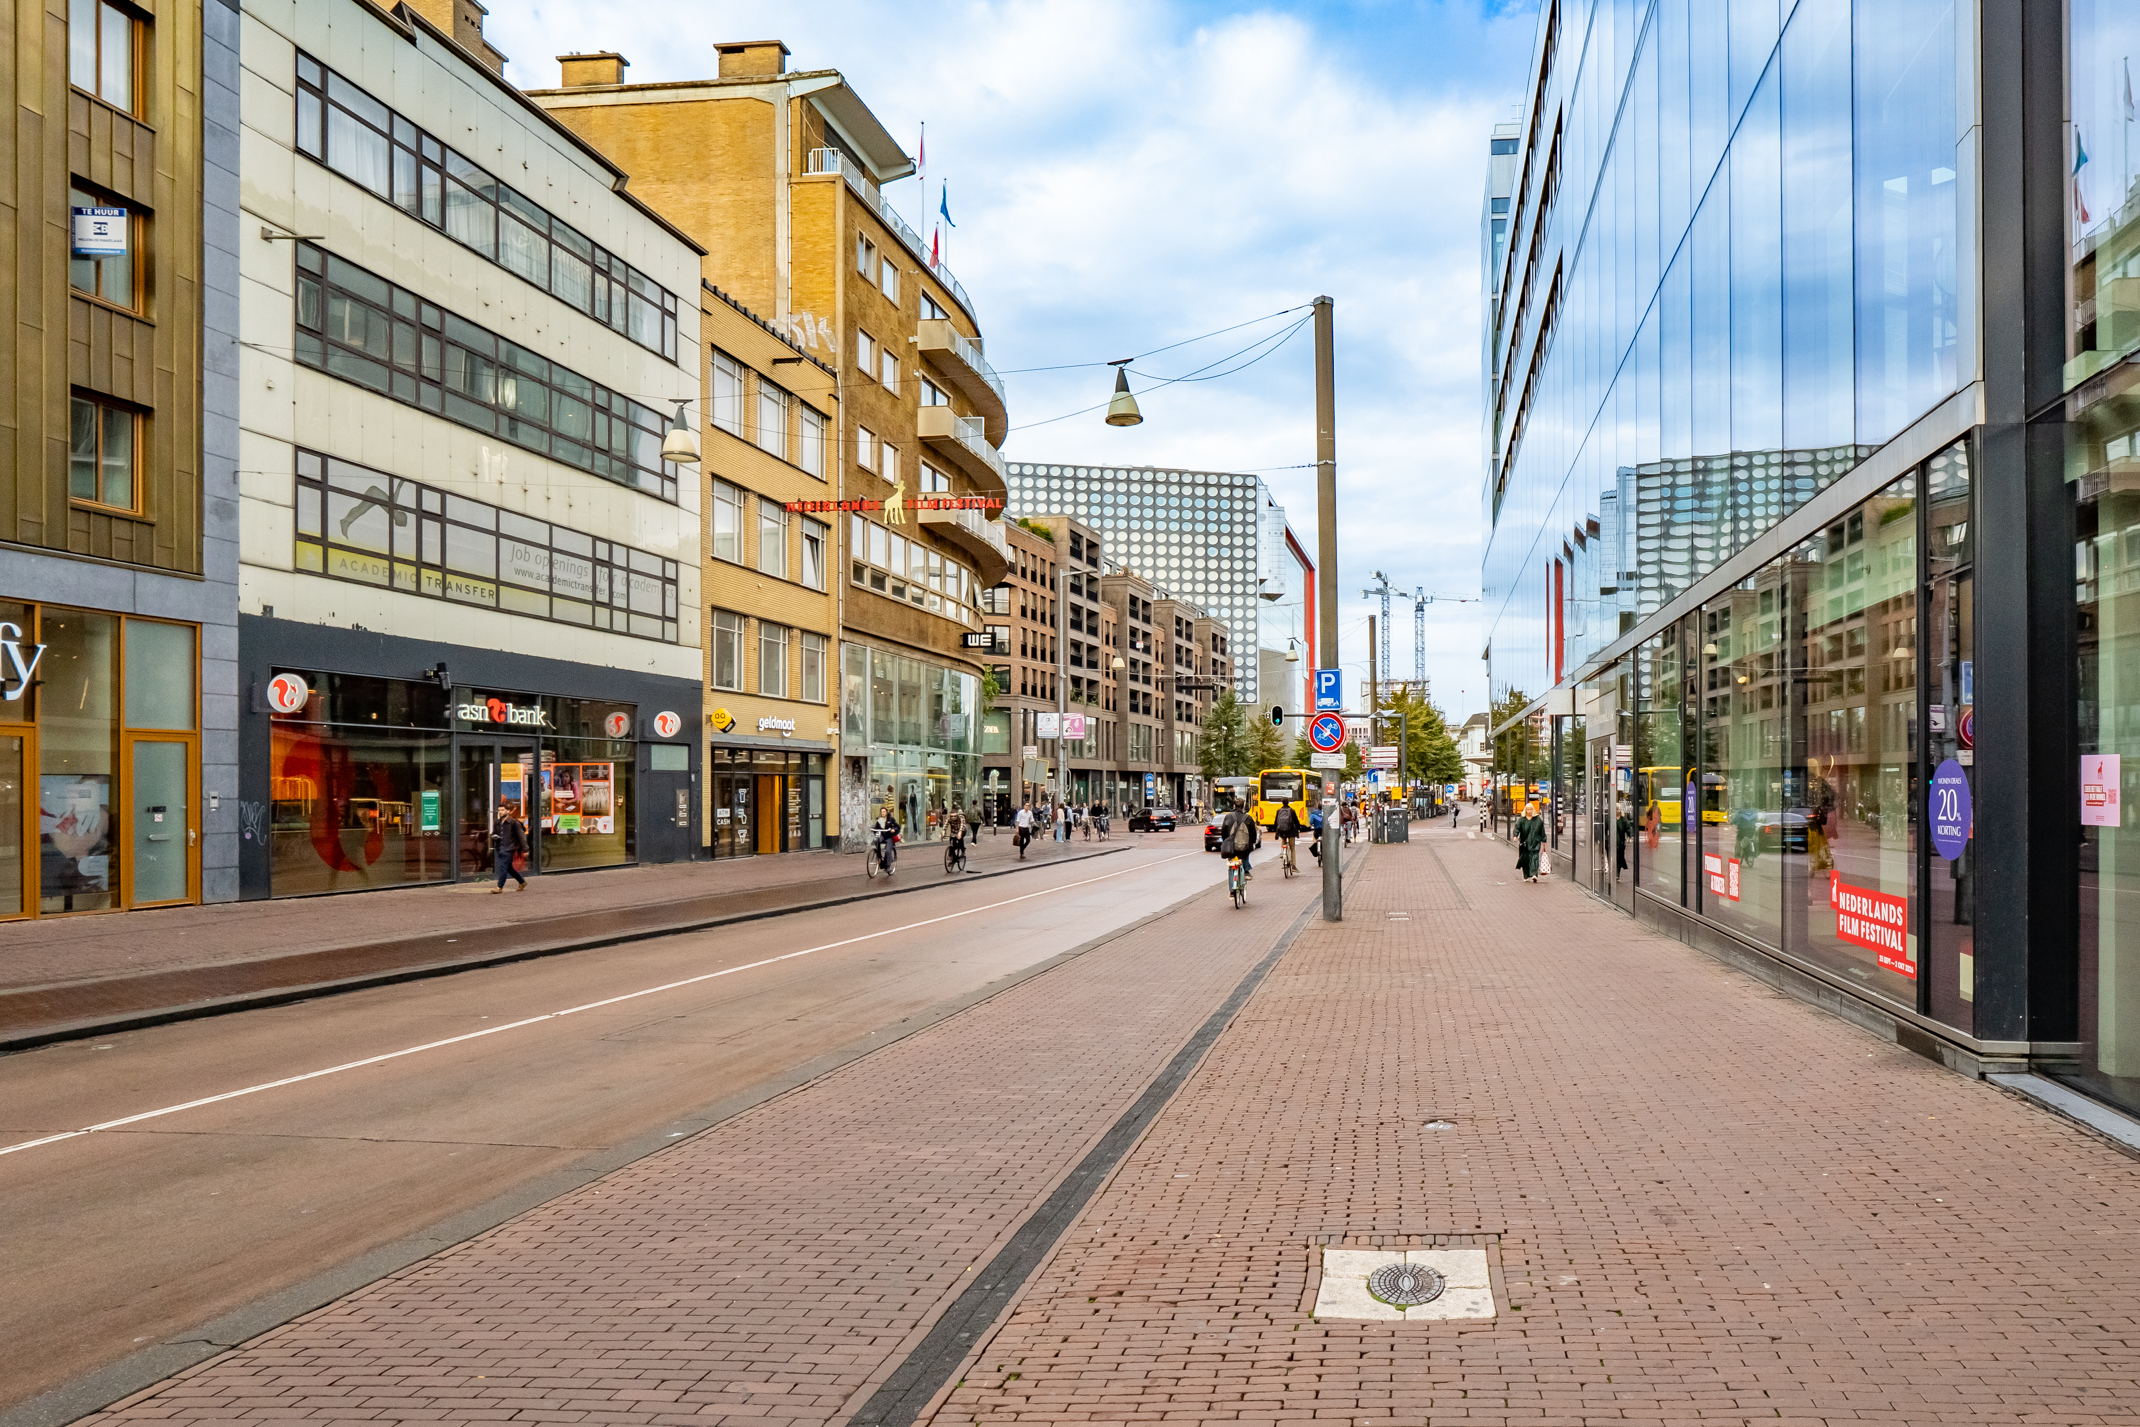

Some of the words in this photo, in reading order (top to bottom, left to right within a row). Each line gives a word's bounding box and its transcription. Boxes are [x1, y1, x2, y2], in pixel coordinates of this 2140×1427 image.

[786, 501, 880, 512] NEDERLANDS
[907, 499, 938, 510] FILM
[943, 498, 1002, 509] FESTIVAL
[510, 544, 531, 563] Job
[534, 554, 589, 579] openings
[340, 558, 417, 583] ACADEMIC
[426, 575, 495, 600] TRANSFER
[968, 634, 991, 646] WE
[1321, 673, 1336, 694] P
[457, 703, 489, 721] asn
[506, 703, 547, 725] bank
[1937, 825, 1962, 837] KORTING
[1839, 891, 1903, 926] NEDERLANDS
[1839, 913, 1859, 937] FILM
[1860, 920, 1903, 952] FESTIVAL
